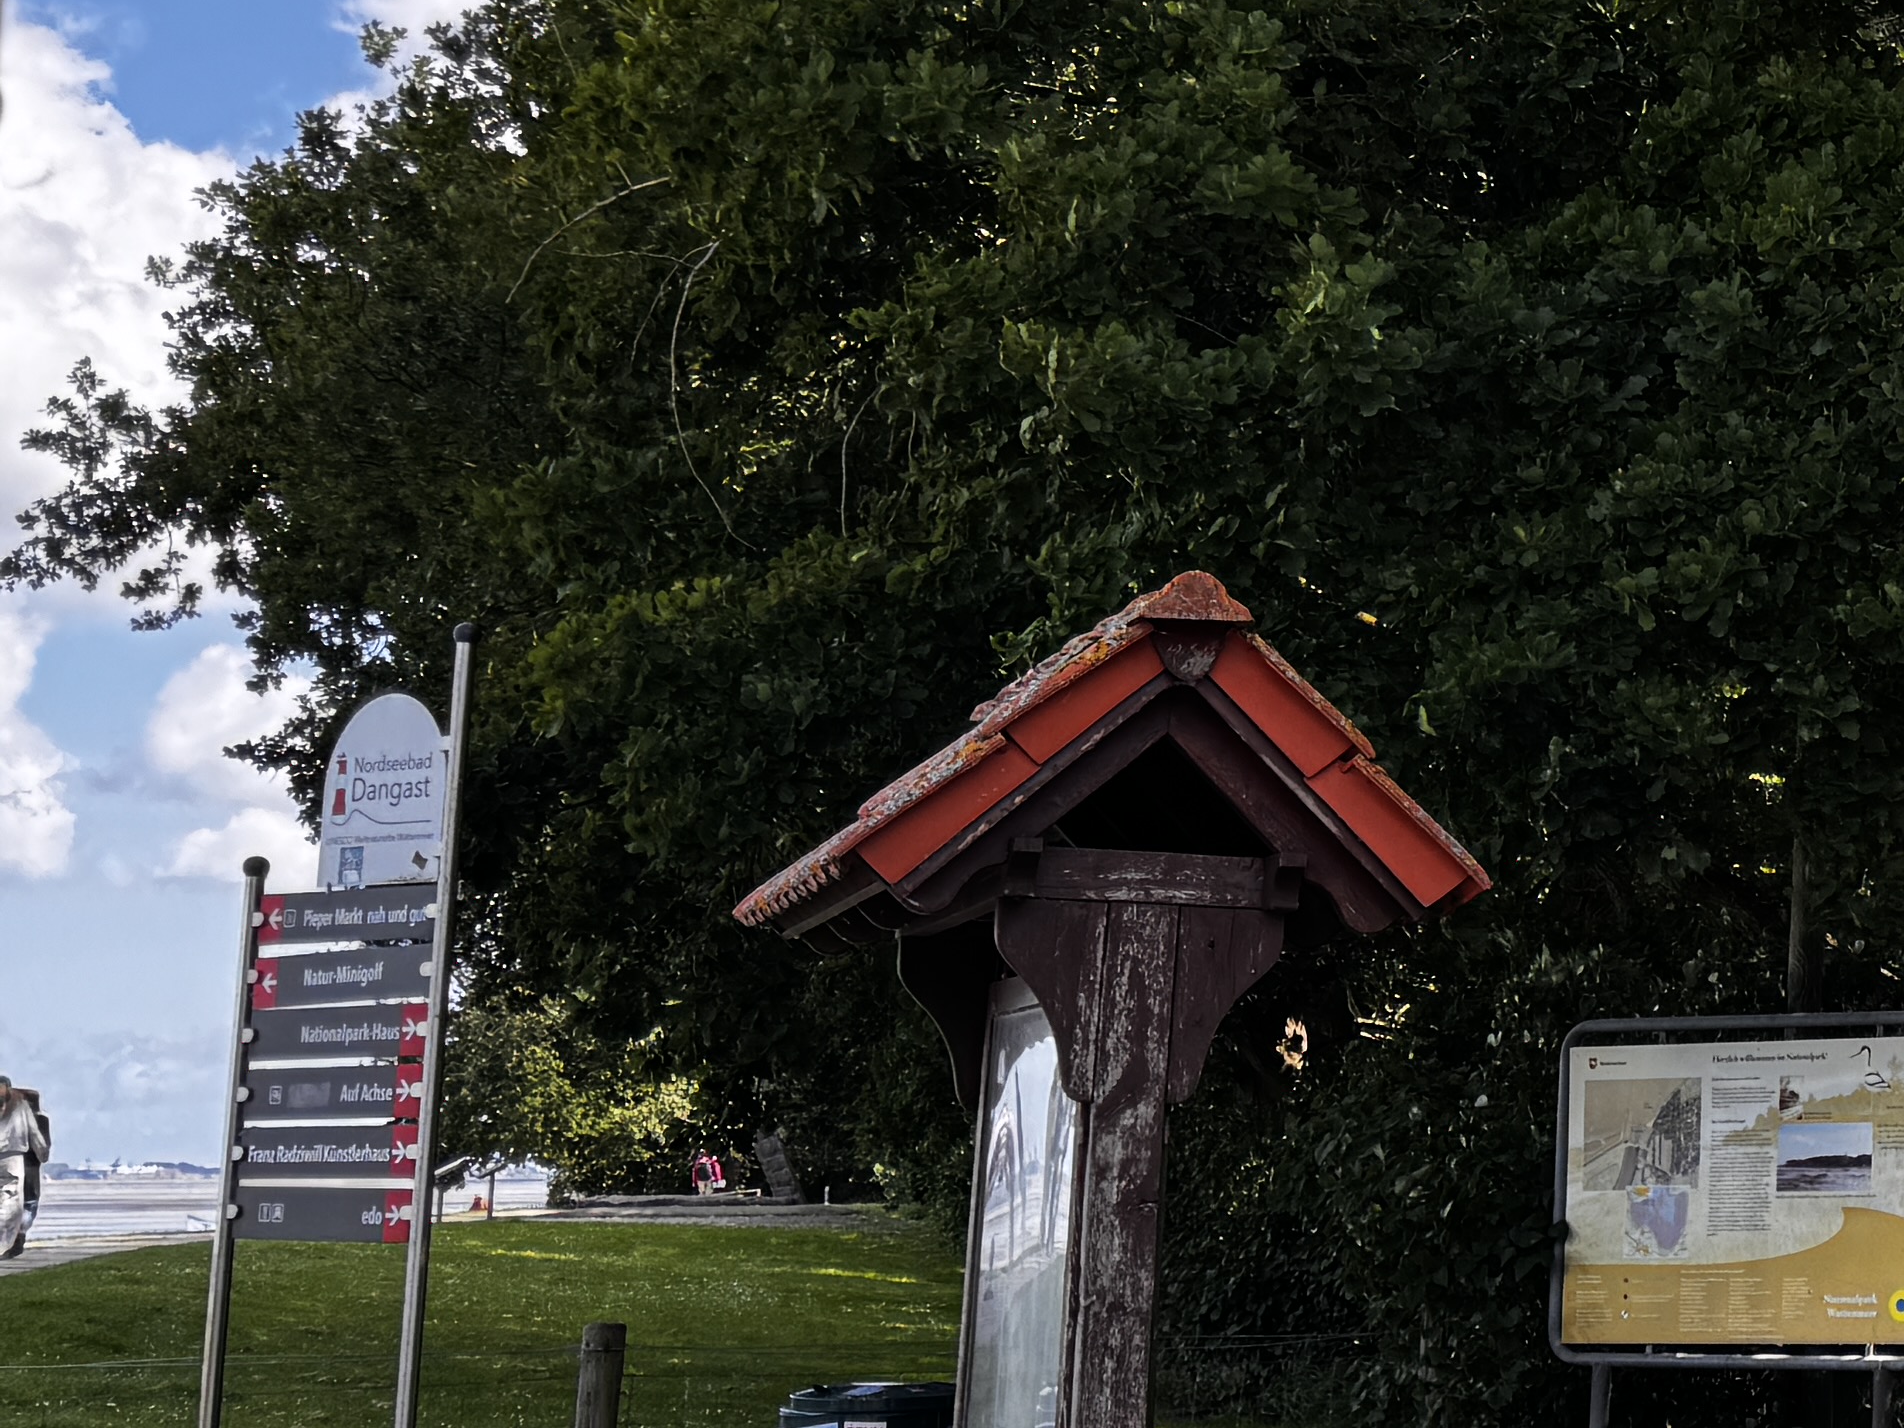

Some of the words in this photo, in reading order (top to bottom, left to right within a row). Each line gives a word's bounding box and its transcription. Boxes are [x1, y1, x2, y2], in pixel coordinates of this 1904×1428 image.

[354, 752, 433, 773] Nordseebad
[351, 776, 431, 807] Dangast
[334, 906, 363, 925] Markt
[387, 903, 408, 923] und
[303, 960, 385, 987] Natur-Minigolf
[300, 1022, 401, 1047] Nationalpark-Haus
[339, 1082, 360, 1103] Auf
[360, 1082, 393, 1102] Achse
[361, 1205, 383, 1225] edo
